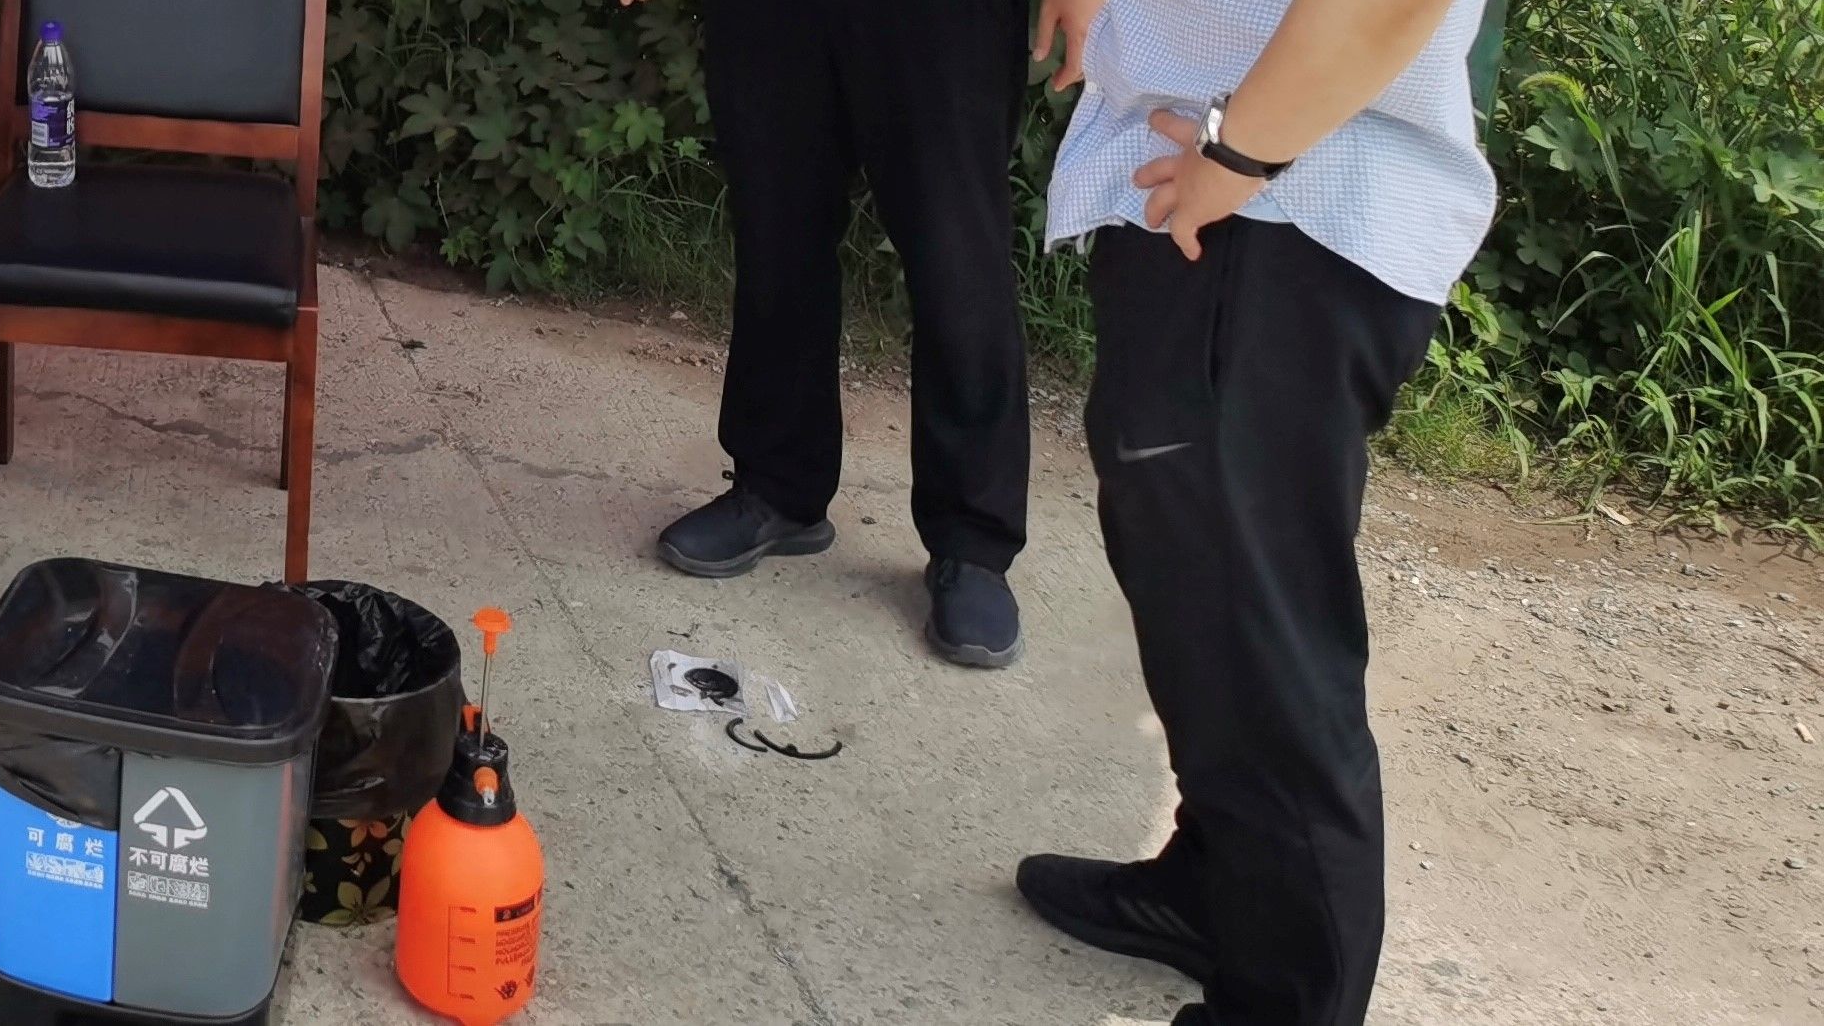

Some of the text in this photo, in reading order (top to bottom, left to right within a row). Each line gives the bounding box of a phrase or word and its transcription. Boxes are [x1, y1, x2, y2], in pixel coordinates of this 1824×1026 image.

[26, 826, 105, 859] 可腐烂
[128, 846, 211, 878] 不可腐烂
